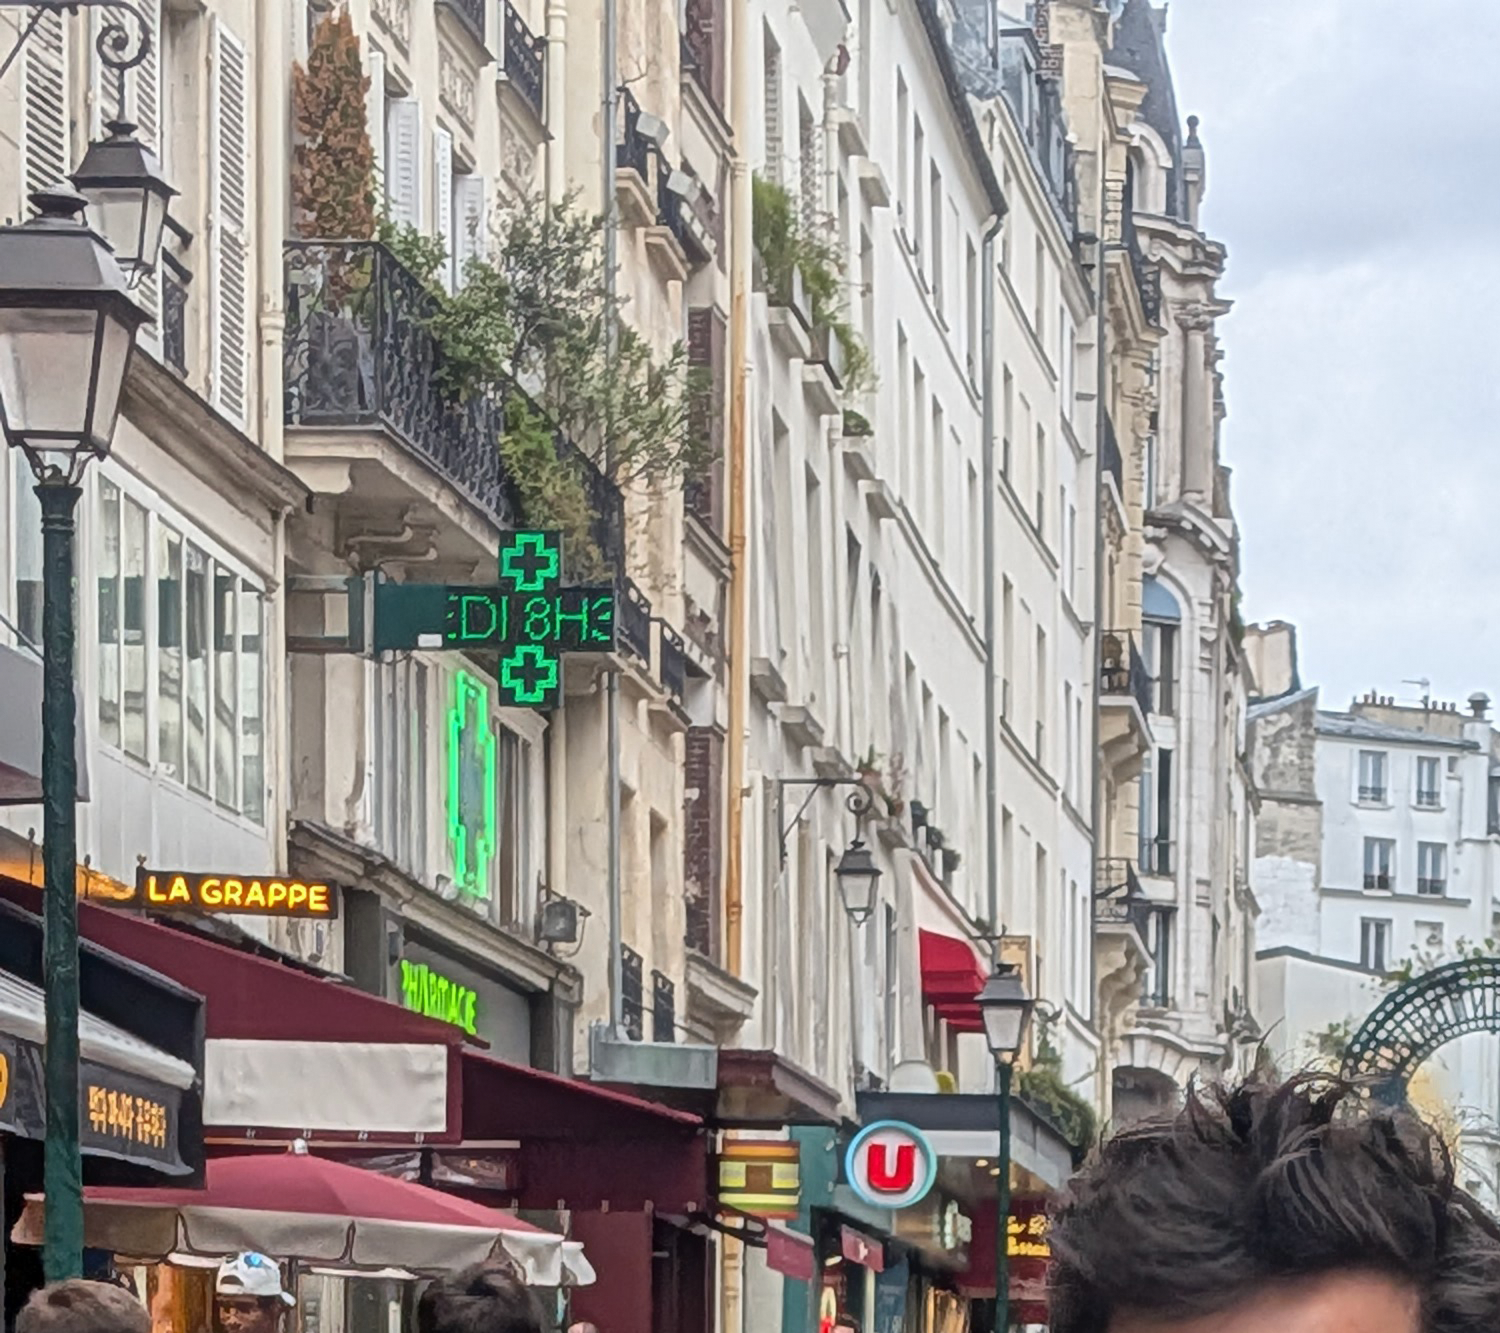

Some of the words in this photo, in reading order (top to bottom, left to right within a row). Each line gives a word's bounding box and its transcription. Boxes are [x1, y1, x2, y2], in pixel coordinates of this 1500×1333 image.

[149, 875, 191, 902] LA
[201, 878, 330, 912] GRAPPE
[867, 1143, 916, 1196] U
